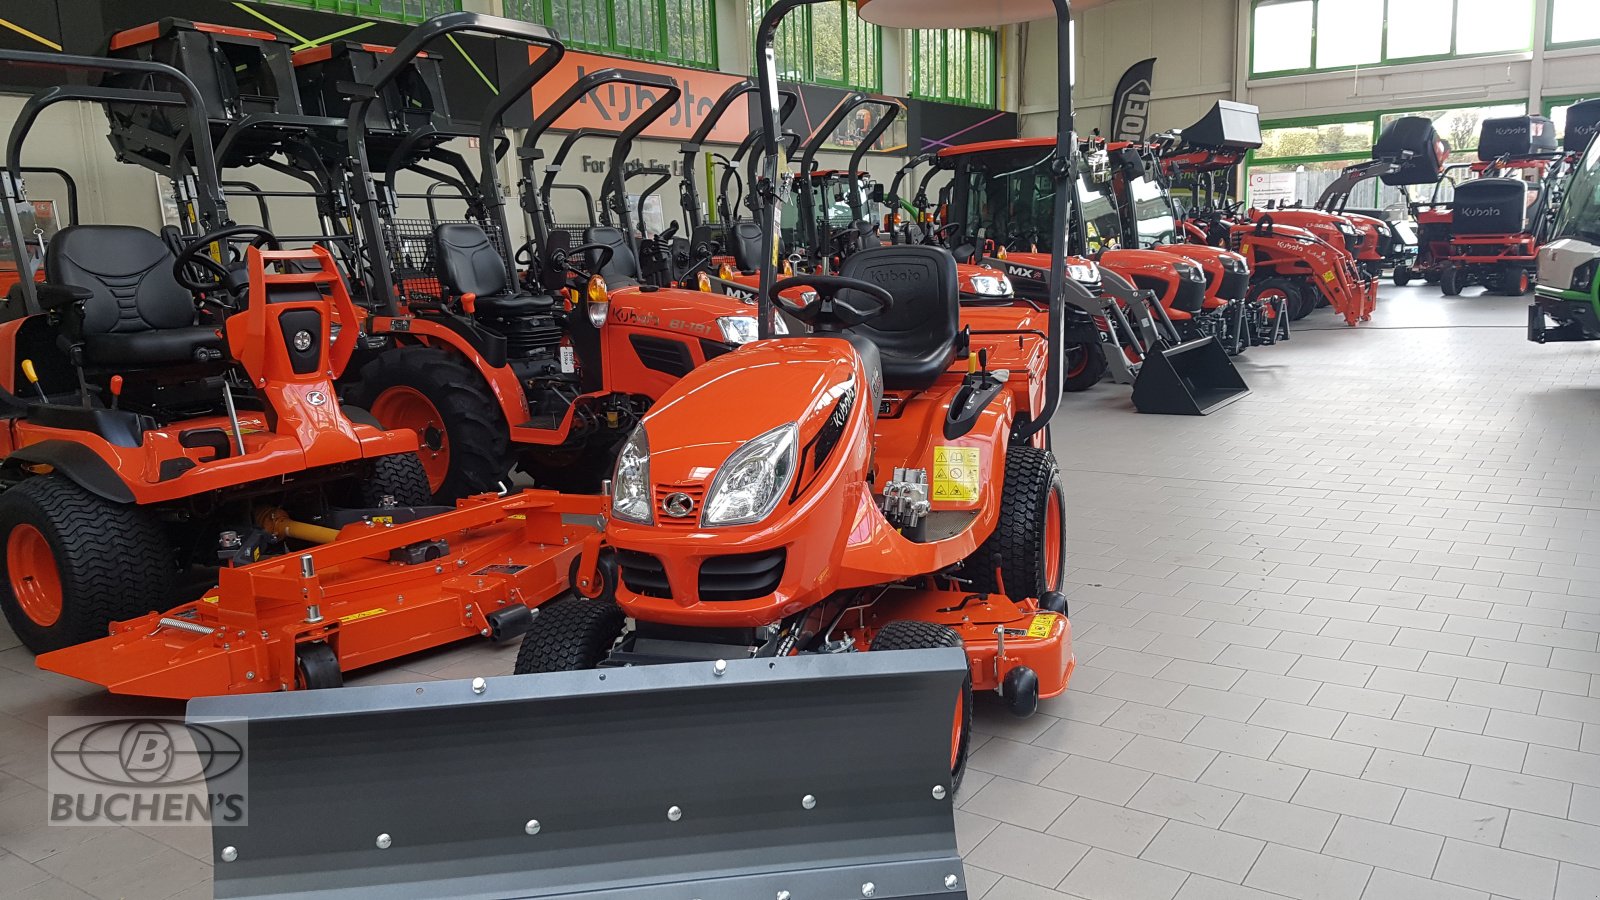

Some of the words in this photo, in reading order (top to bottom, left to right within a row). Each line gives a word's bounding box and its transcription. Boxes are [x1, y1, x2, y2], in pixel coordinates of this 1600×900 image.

[1495, 127, 1527, 135] Kubota
[582, 155, 606, 173] For
[1461, 206, 1501, 217] Kubota
[1277, 240, 1304, 252] Kubota
[871, 270, 921, 283] Kubota
[1008, 265, 1032, 279] MX
[612, 307, 660, 327] Kubota
[833, 388, 855, 428] Kubota
